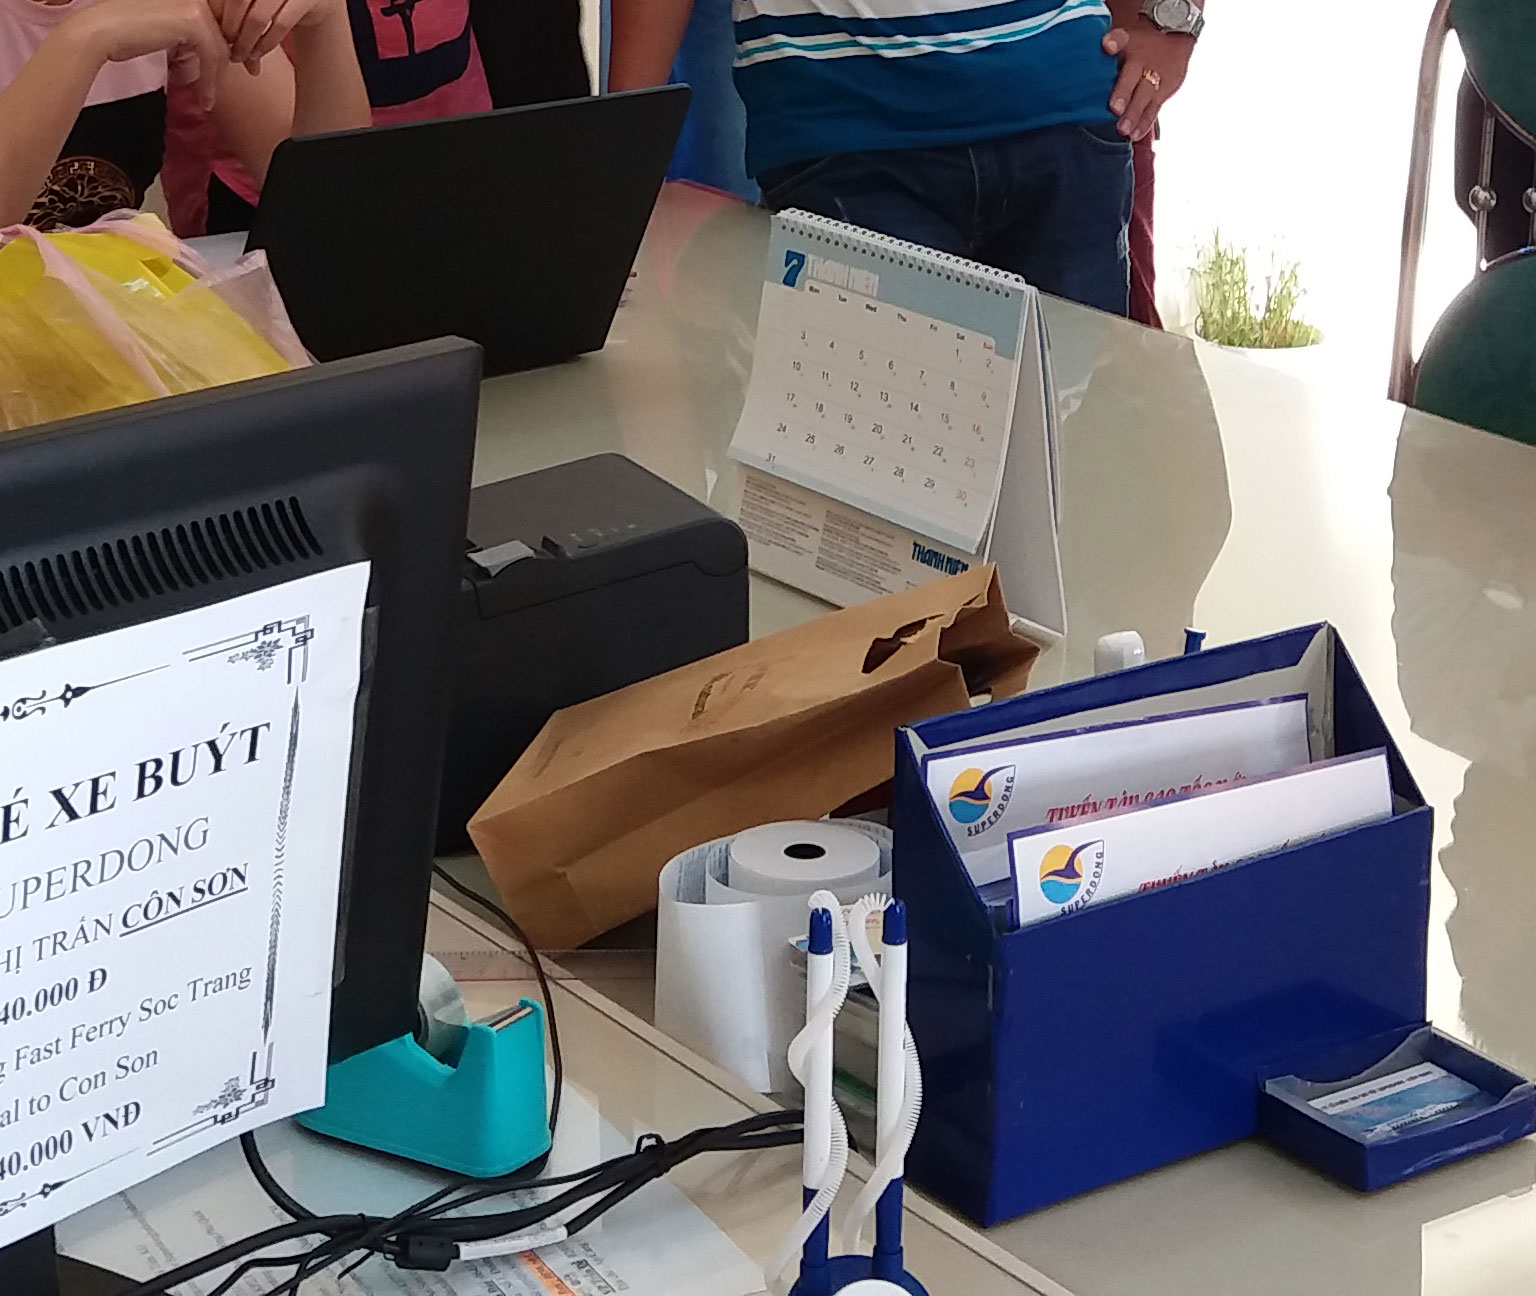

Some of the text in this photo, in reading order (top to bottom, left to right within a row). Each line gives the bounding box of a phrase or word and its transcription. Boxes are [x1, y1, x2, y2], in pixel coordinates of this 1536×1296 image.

[782, 249, 806, 288] 7
[792, 360, 802, 372] 10
[822, 370, 829, 381] 11
[850, 380, 860, 392] 12
[880, 390, 889, 402] 13
[910, 401, 920, 413] 14
[786, 392, 796, 403] 17
[815, 402, 825, 414] 18
[871, 423, 883, 435] 20
[902, 433, 913, 445] 21
[932, 444, 944, 457] 22
[805, 433, 816, 445] 25
[863, 455, 875, 466] 27
[892, 465, 905, 478] 28
[44, 770, 118, 830] XE
[131, 721, 272, 802] BUÝT
[966, 775, 1015, 838] SUPERDONG
[32, 913, 113, 962] TRẤN
[120, 888, 185, 931] CÔN
[190, 862, 249, 905] SƠN
[1060, 850, 1104, 916] SUPERDONG
[86, 967, 108, 995] Đ
[14, 1037, 64, 1072] Fast
[70, 1010, 132, 1050] Ferry
[138, 992, 180, 1023] Soc
[186, 966, 252, 1004] Trang
[28, 1093, 52, 1118] to
[58, 1070, 107, 1103] Con
[114, 1048, 159, 1082] Son
[81, 1100, 142, 1143] VNĐ
